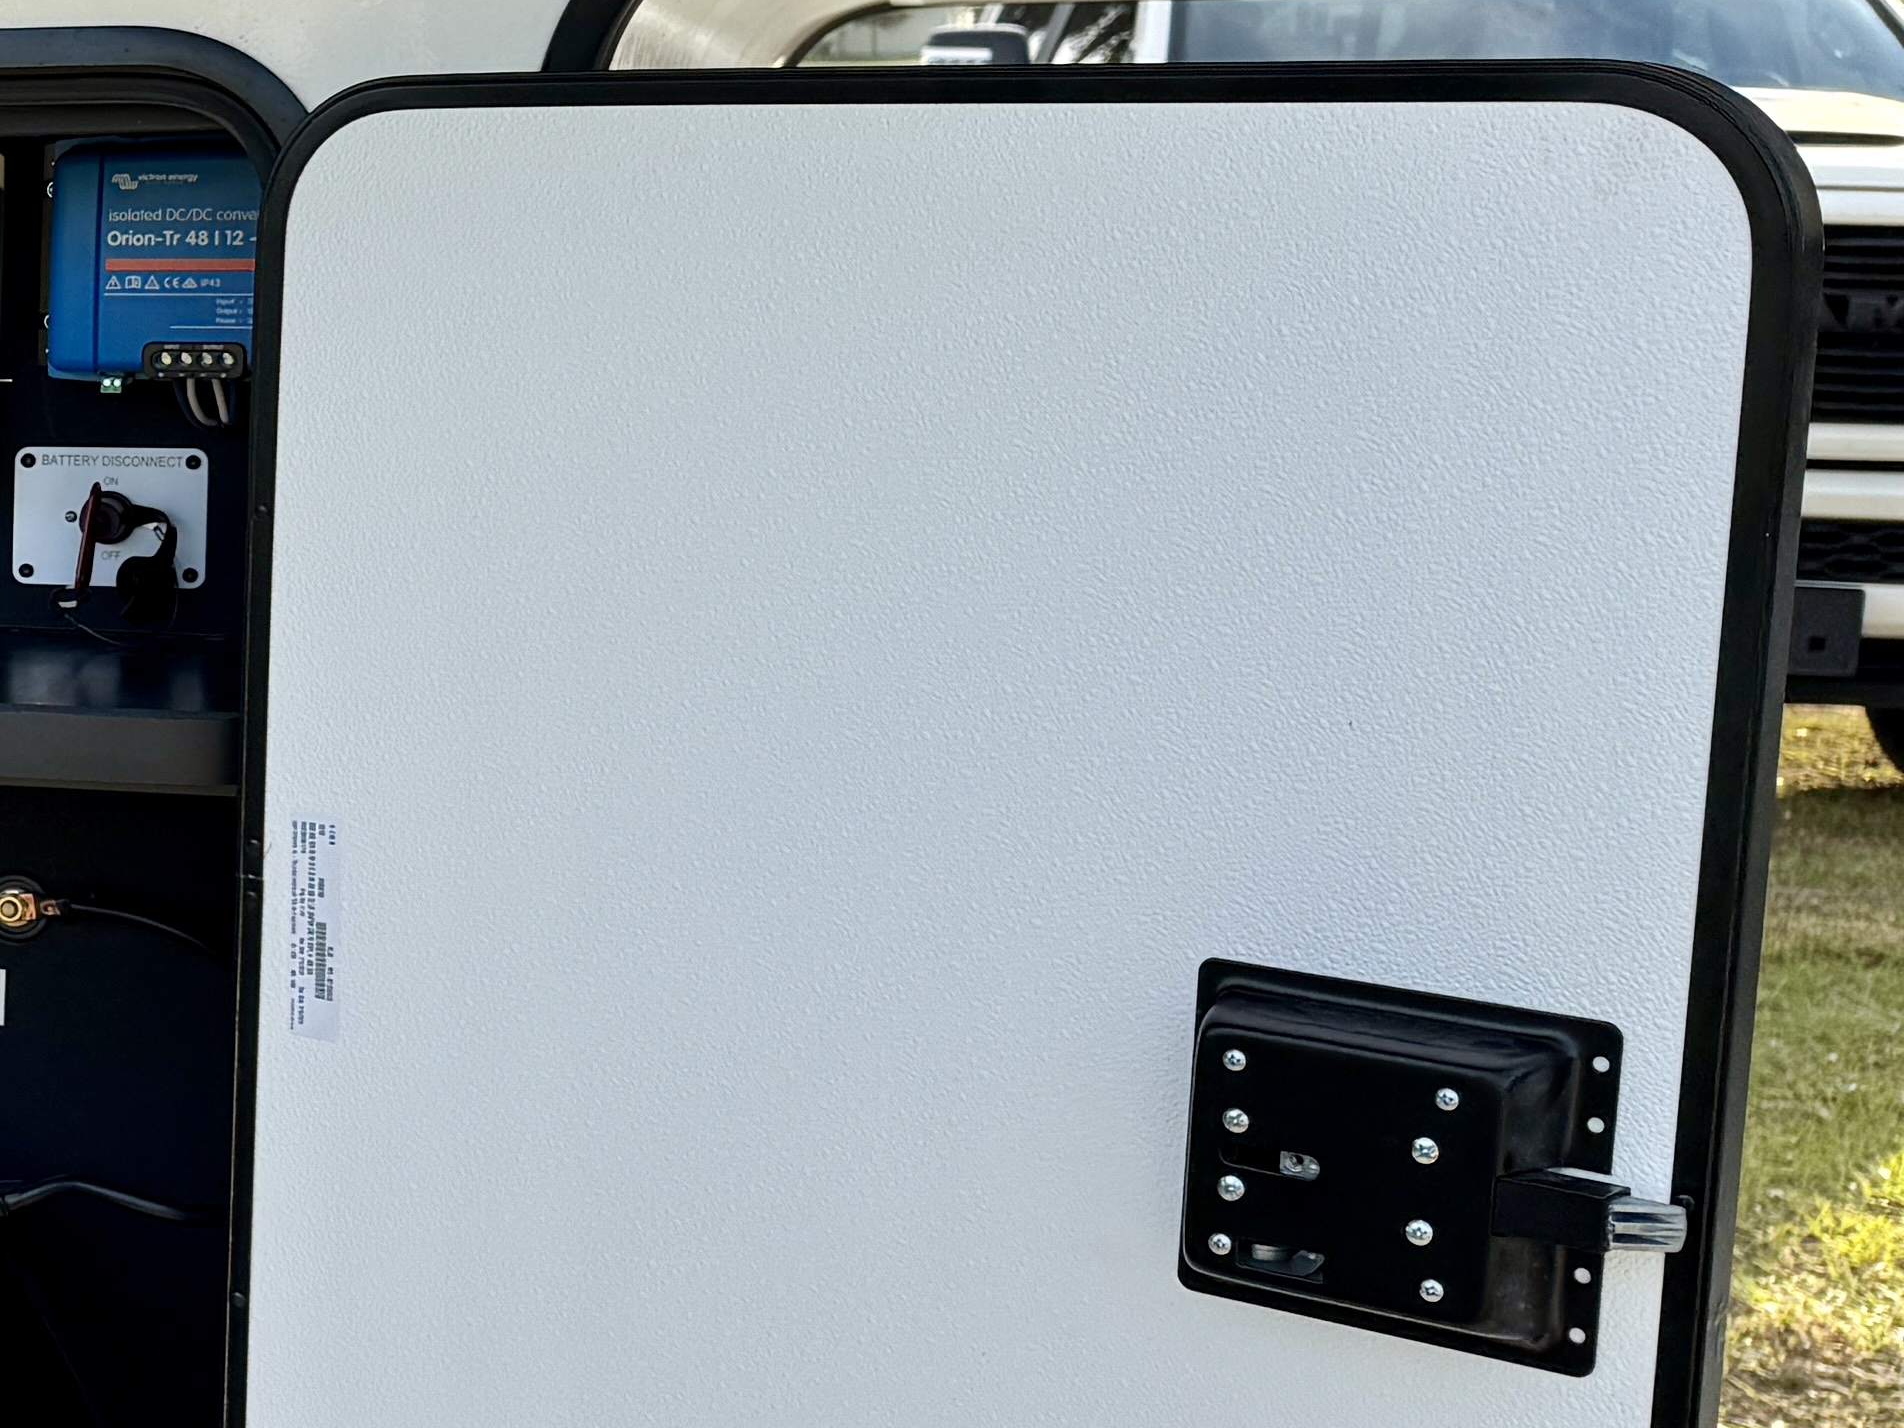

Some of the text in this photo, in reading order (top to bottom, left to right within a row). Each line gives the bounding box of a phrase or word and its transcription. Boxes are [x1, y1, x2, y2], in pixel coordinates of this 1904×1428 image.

[138, 173, 198, 182] victron energy
[109, 208, 258, 221] isolated DC/DC conve
[107, 230, 182, 246] Orion-Tr
[185, 230, 209, 246] 48
[225, 231, 243, 246] 12
[42, 455, 184, 468] BATTERY DISCONNECT
[103, 476, 119, 486] ON
[101, 551, 121, 561] OFF
